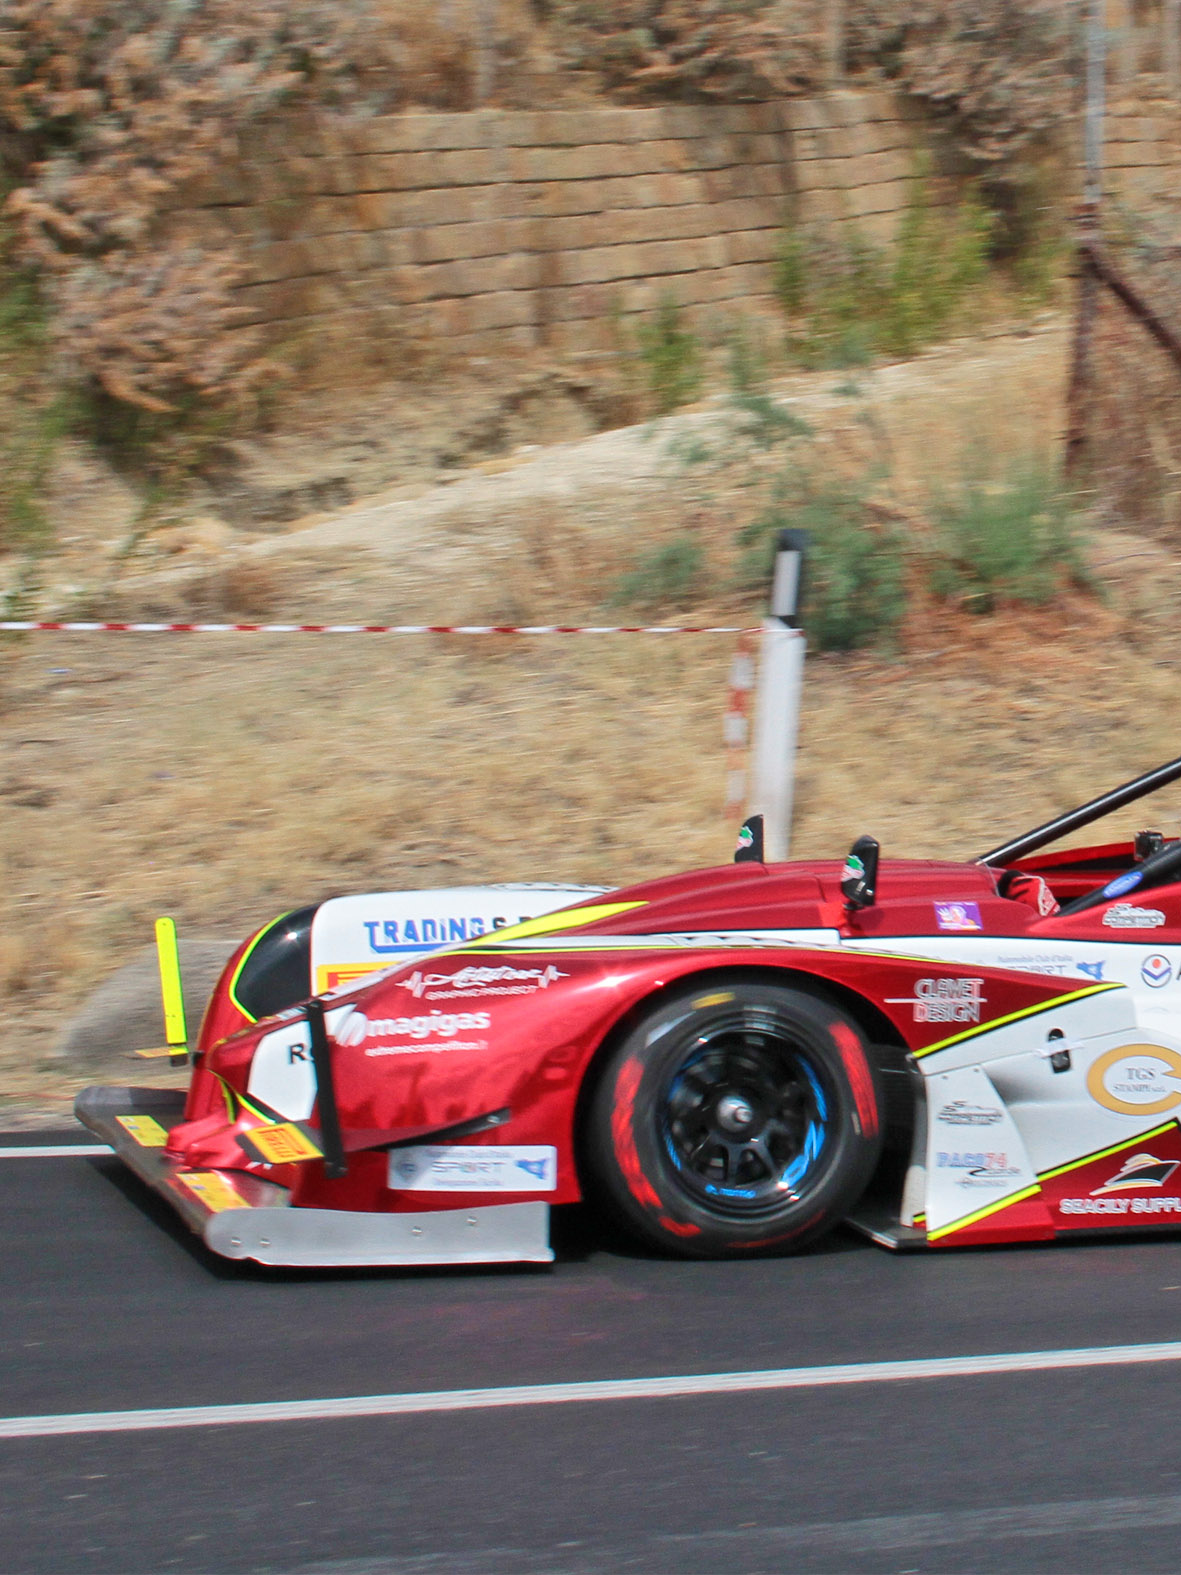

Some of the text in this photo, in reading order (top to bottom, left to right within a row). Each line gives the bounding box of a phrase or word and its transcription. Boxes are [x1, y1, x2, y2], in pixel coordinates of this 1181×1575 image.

[363, 917, 486, 951] TRADING
[913, 1001, 980, 1022] DESIGN
[366, 1013, 491, 1039] magigas
[1059, 1198, 1130, 1214] SEACILY
